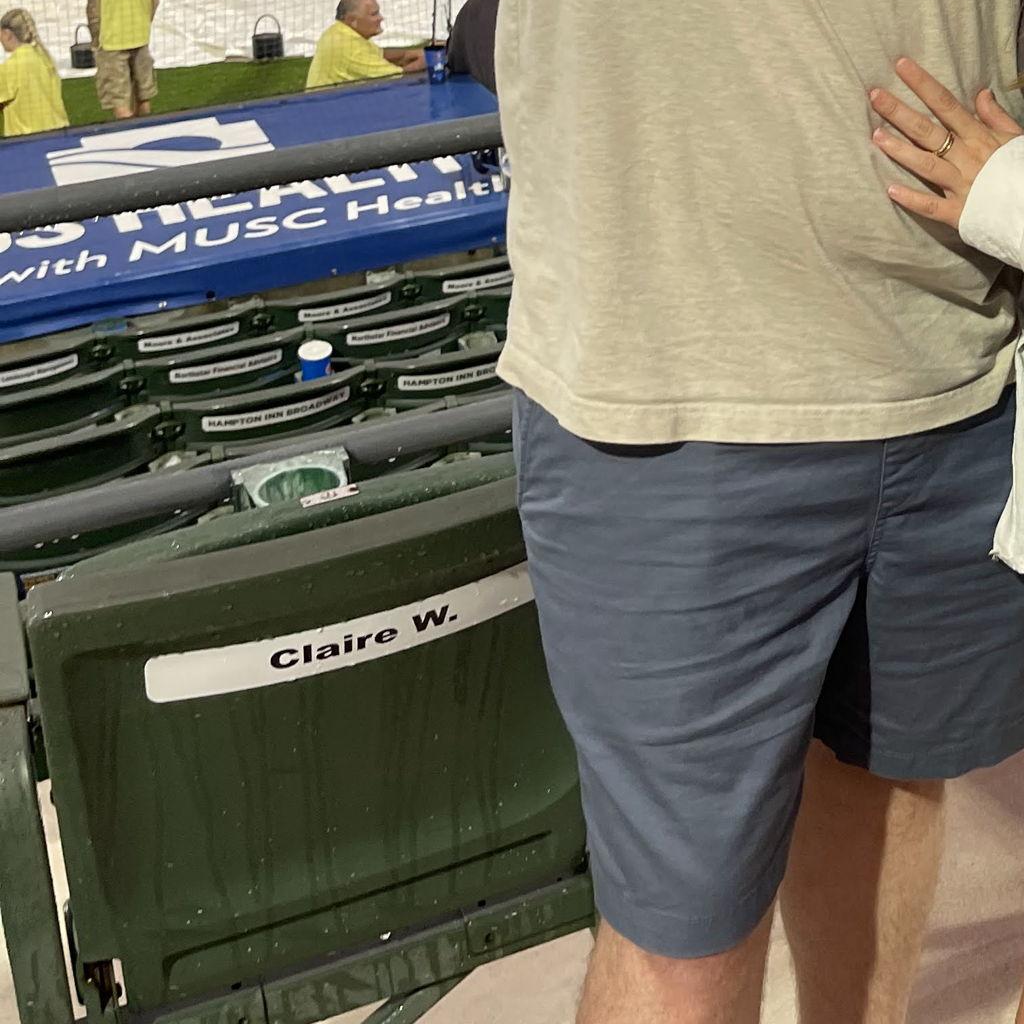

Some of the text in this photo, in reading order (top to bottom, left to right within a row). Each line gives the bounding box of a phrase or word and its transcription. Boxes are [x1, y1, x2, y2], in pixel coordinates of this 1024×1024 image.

[129, 207, 328, 262] MUSC
[403, 376, 453, 387] HAMPTON
[455, 371, 474, 382] INN
[208, 392, 346, 428] HAMPTON INN BROADWAY
[269, 604, 458, 670] Claire W.
